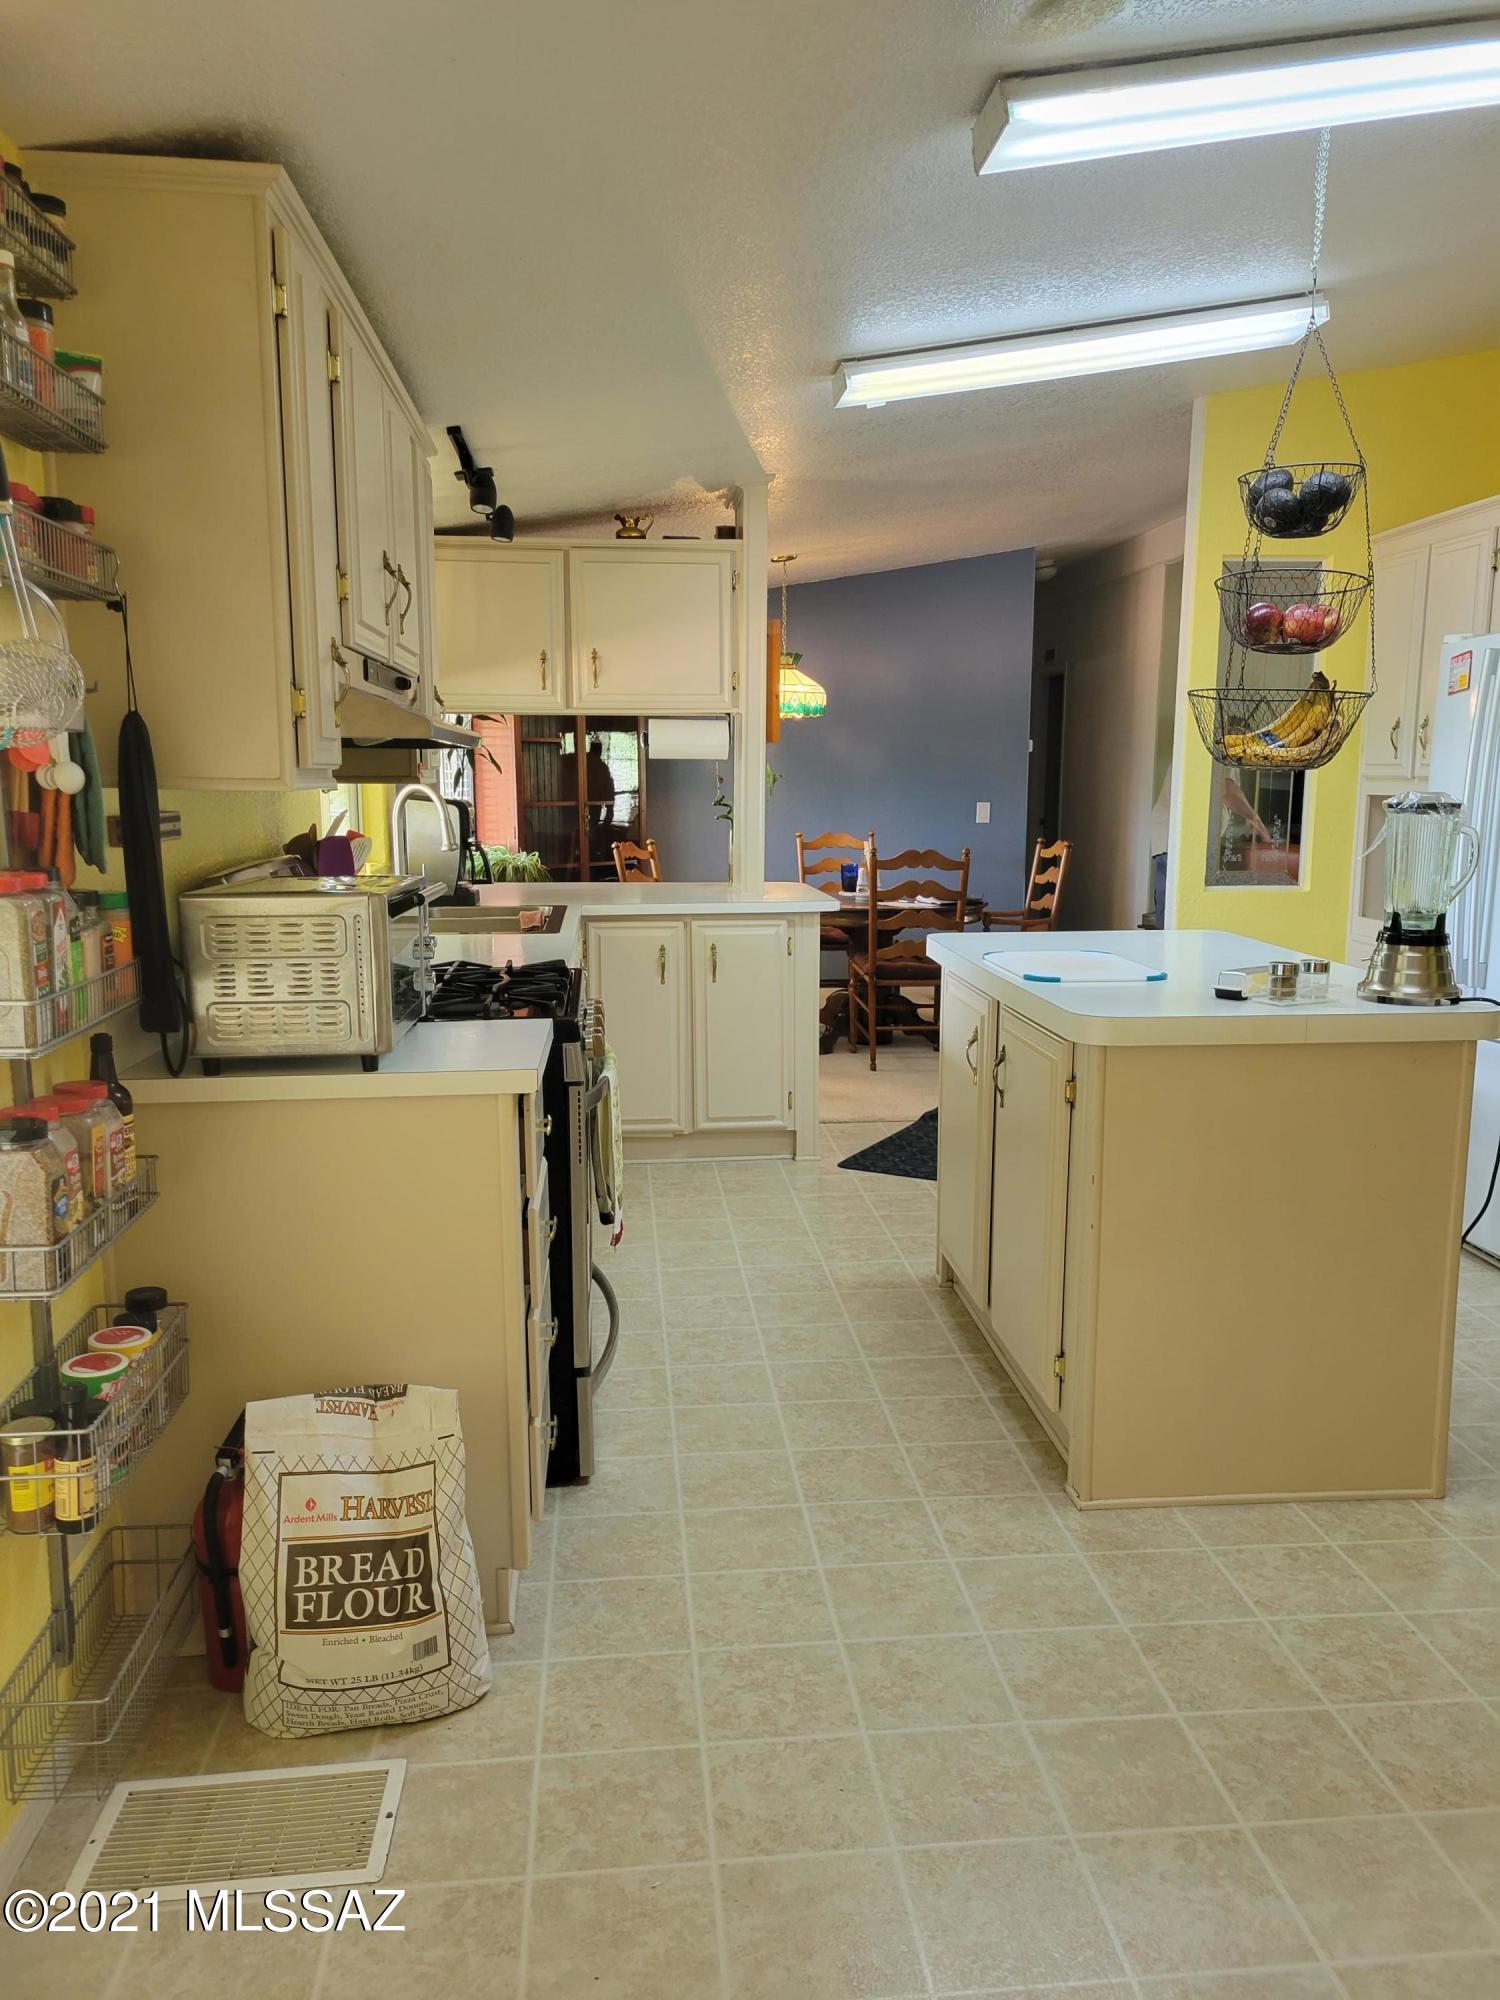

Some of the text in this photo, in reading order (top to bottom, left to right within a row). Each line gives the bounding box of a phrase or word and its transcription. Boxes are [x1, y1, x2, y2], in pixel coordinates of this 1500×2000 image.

[340, 1490, 432, 1521] HARVEST
[283, 1513, 338, 1524] Ardent Mills
[293, 1547, 425, 1588] BREAD
[293, 1582, 431, 1623] FLOUR
[322, 1632, 404, 1646] Enriched Bleached
[329, 1677, 348, 1686] WT
[350, 1676, 362, 1684] 25
[364, 1675, 379, 1683] LB
[382, 1664, 423, 1682] (11.34kg)
[286, 1702, 313, 1712] IDEAL
[362, 1702, 392, 1710] Breads,
[395, 1698, 416, 1706] Pizza
[418, 1689, 444, 1700] Crust,
[286, 1710, 309, 1718] Sweet
[311, 1713, 343, 1721] Dough,
[368, 1707, 396, 1716] Raised
[399, 1701, 431, 1712] Donuts,
[286, 1717, 314, 1727] Hearth
[400, 1710, 416, 1718] Soft
